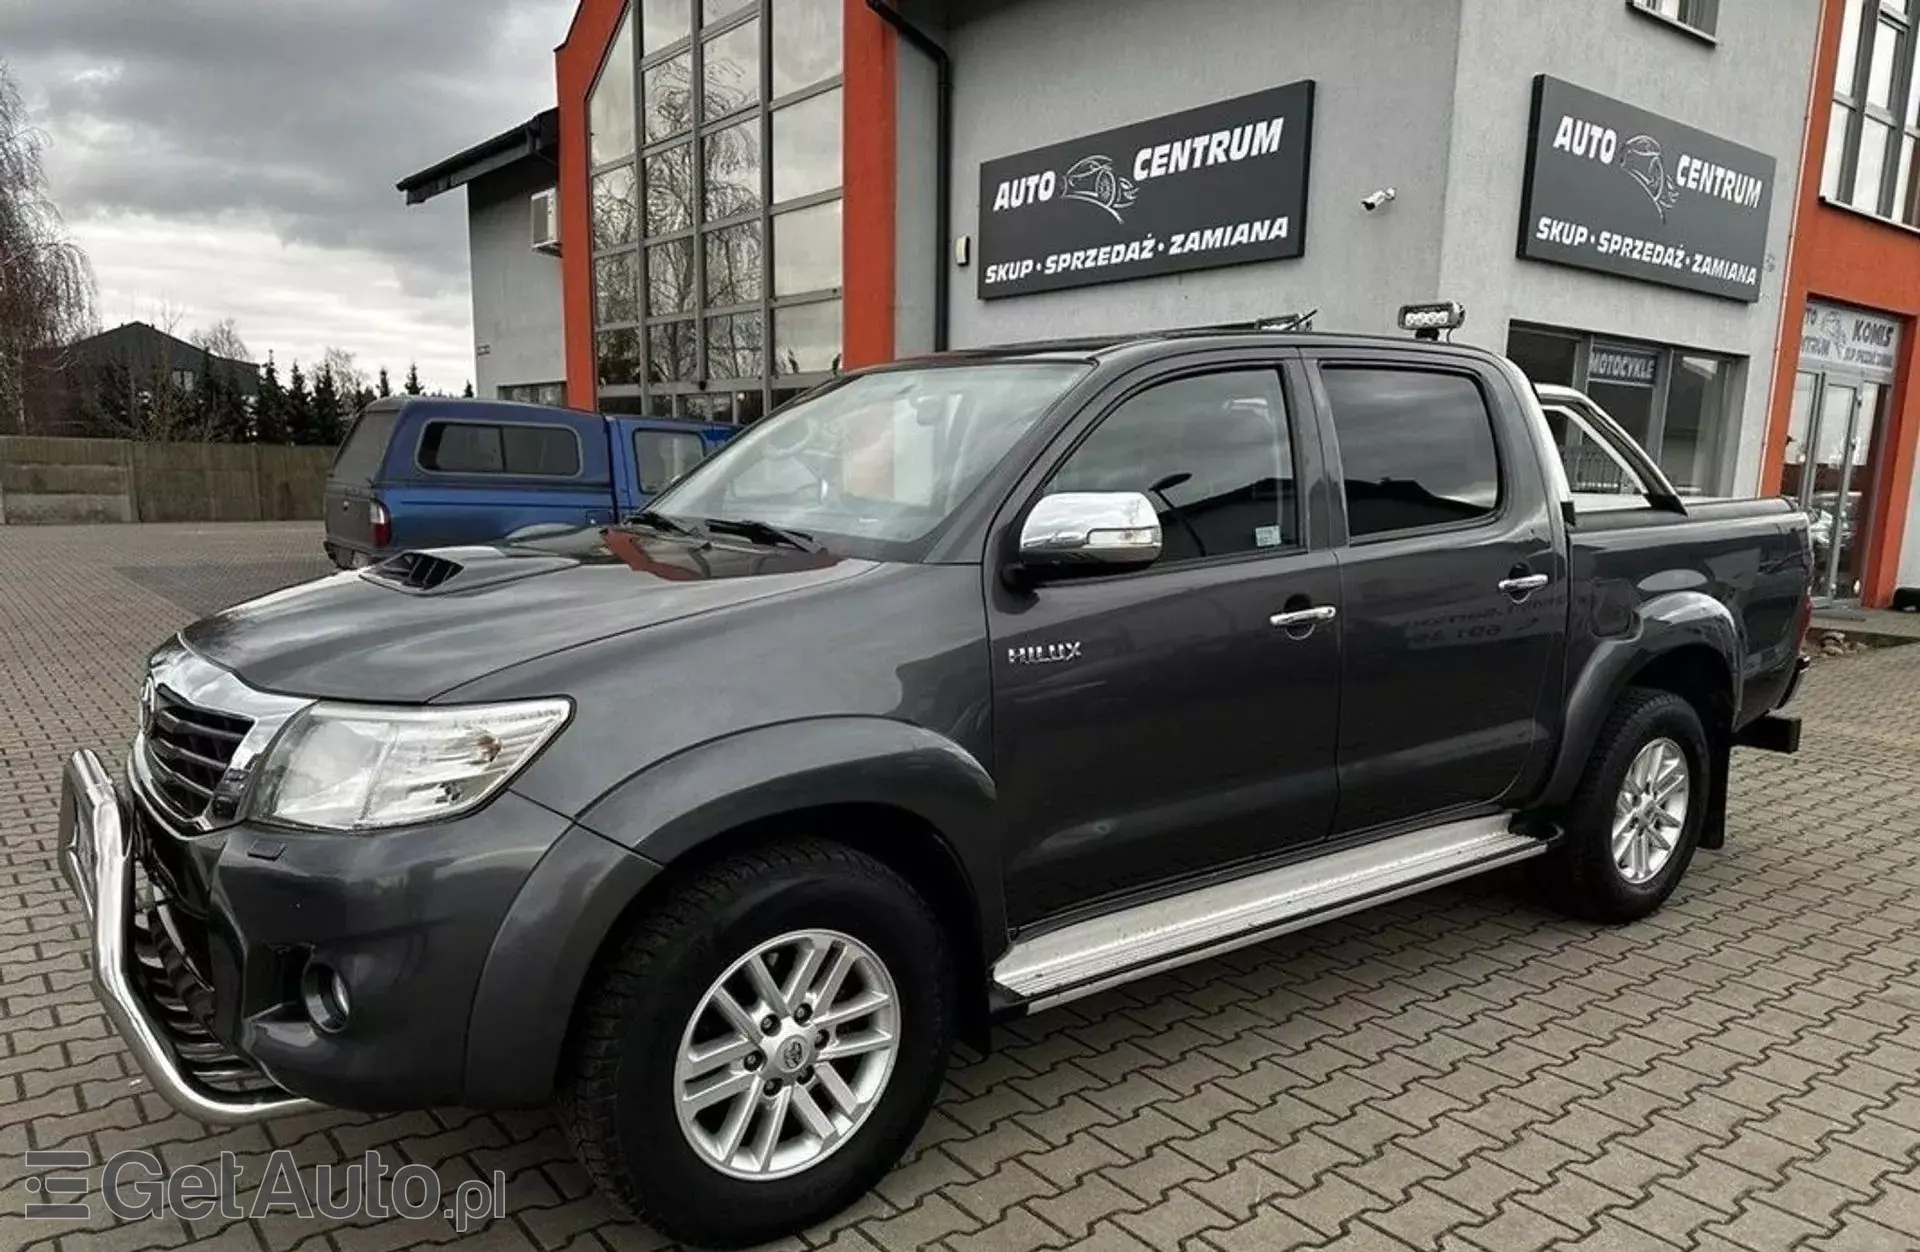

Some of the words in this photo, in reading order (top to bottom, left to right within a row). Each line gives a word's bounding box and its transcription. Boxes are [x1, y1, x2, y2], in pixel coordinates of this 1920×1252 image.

[992, 170, 1056, 212] AUTO
[1132, 117, 1285, 182] CENTRUM
[1552, 115, 1617, 165] AUTO
[1676, 154, 1762, 208] CENTRUM
[985, 259, 1034, 284] SKUP
[1043, 233, 1156, 275] SPRZEDAŻ
[1168, 216, 1289, 255] ZAMIANA
[1535, 216, 1589, 247] SKUP
[1597, 230, 1685, 269] SPRZEDAŻ
[1691, 253, 1759, 286] ZAMIANA
[1589, 351, 1654, 380] MOTOCYKLE
[1851, 318, 1894, 347] KOMIS
[1008, 641, 1082, 664] HILUX
